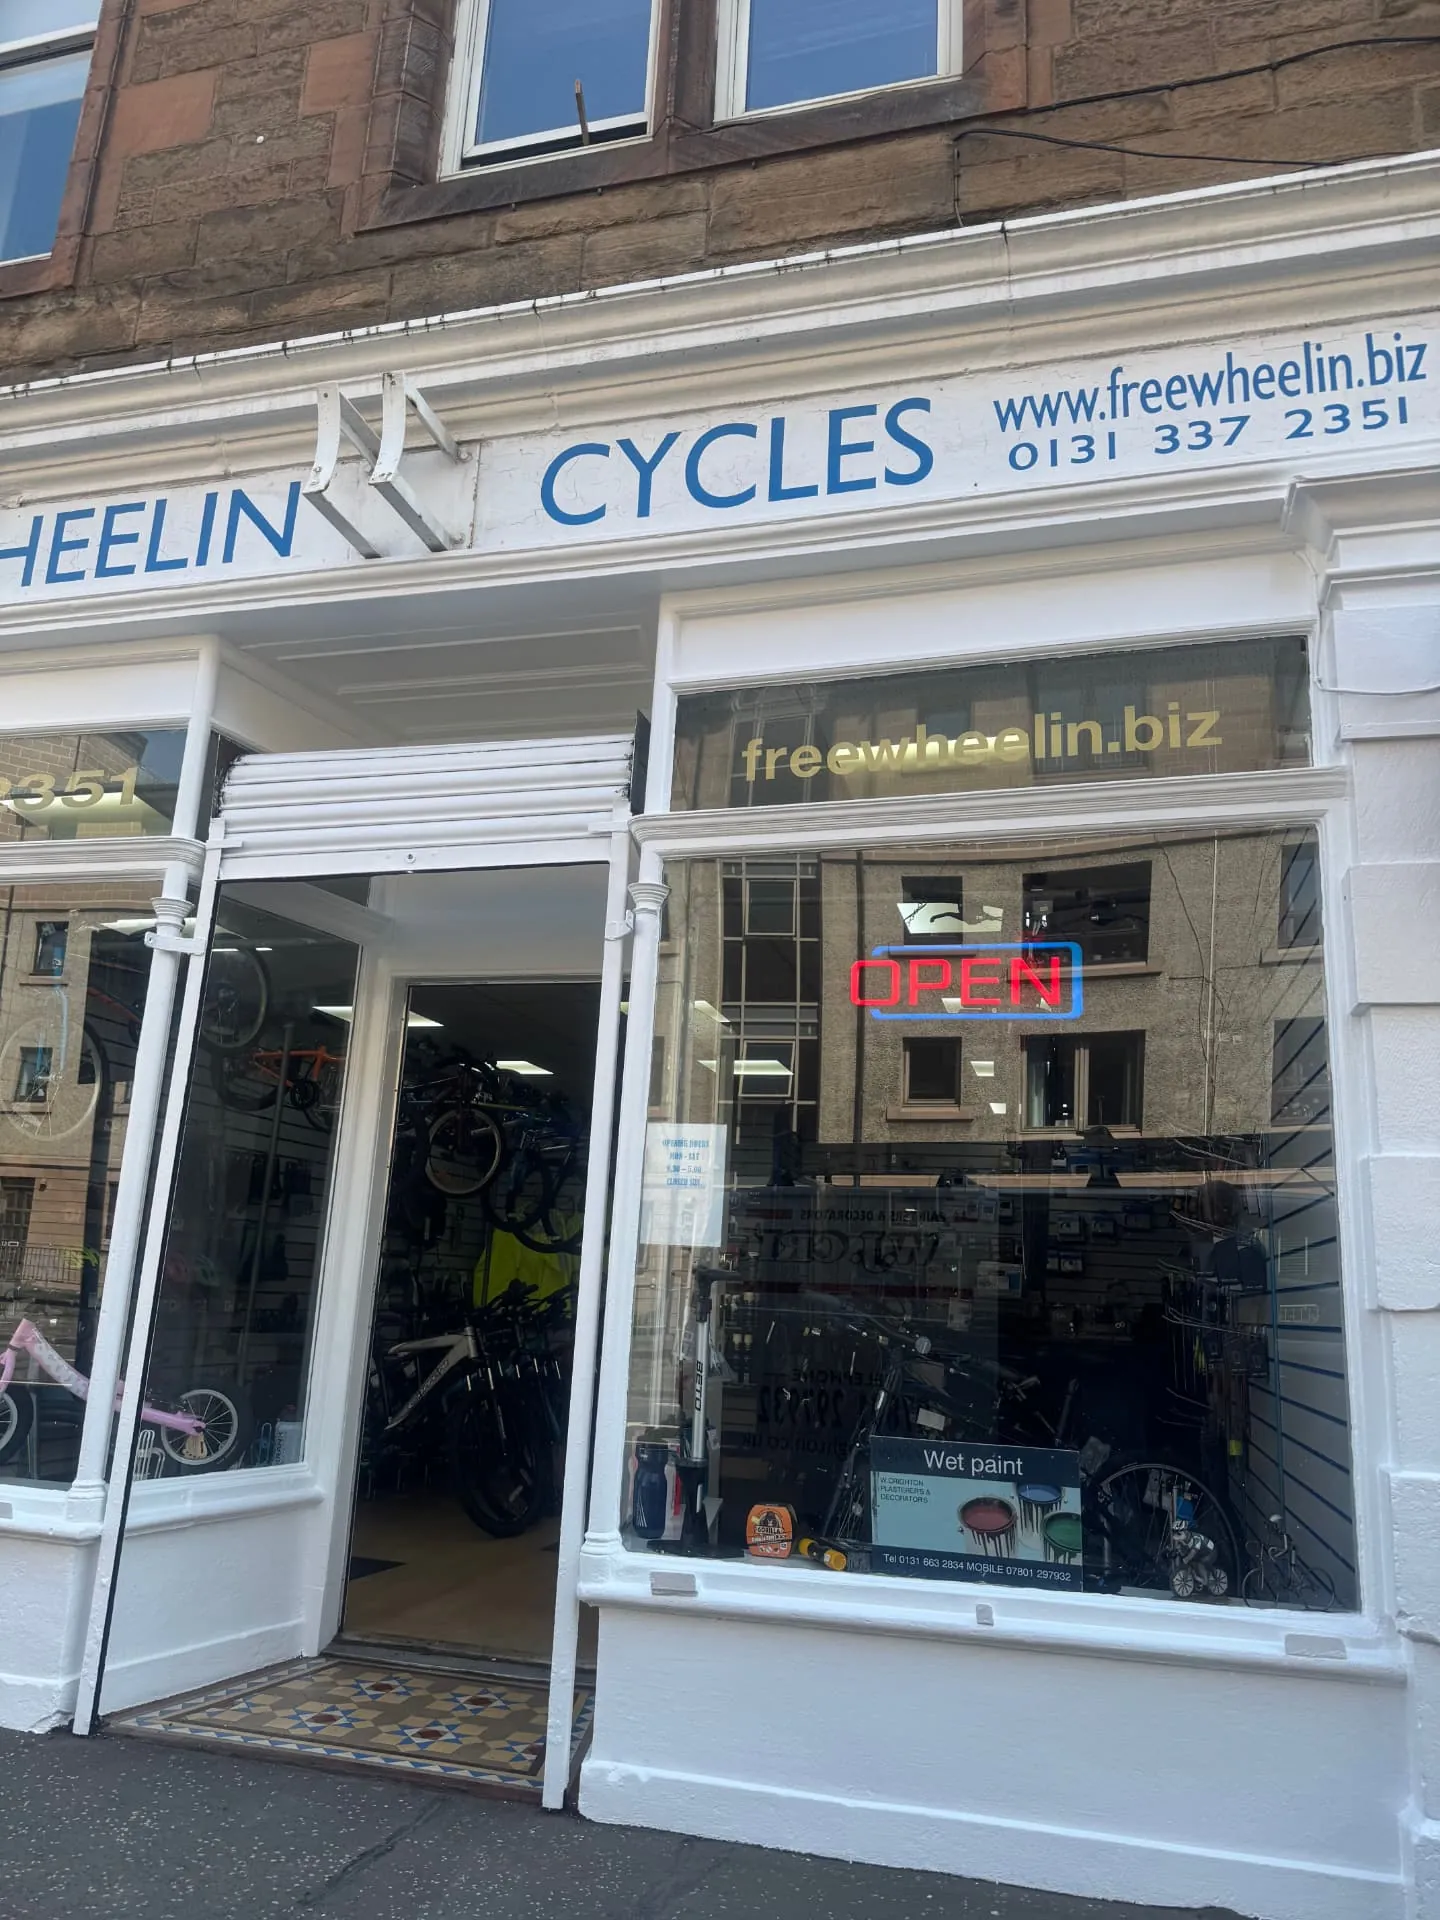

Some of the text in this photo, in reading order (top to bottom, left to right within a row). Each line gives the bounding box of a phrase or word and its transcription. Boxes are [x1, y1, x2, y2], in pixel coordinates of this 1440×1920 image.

[993, 332, 1428, 432] www.freewheelin.biz
[1008, 396, 1408, 471] 0131 337 2351
[540, 396, 935, 526] CYCLES
[742, 700, 1223, 782] freewheelin.biz
[0, 766, 139, 812] 351
[849, 955, 1062, 1007] OPEN
[694, 1359, 704, 1412] BETO
[923, 1449, 1023, 1476] Wet paint
[883, 1553, 1072, 1582] Tel 0131 663 2834 MOBILE 07801 297932
